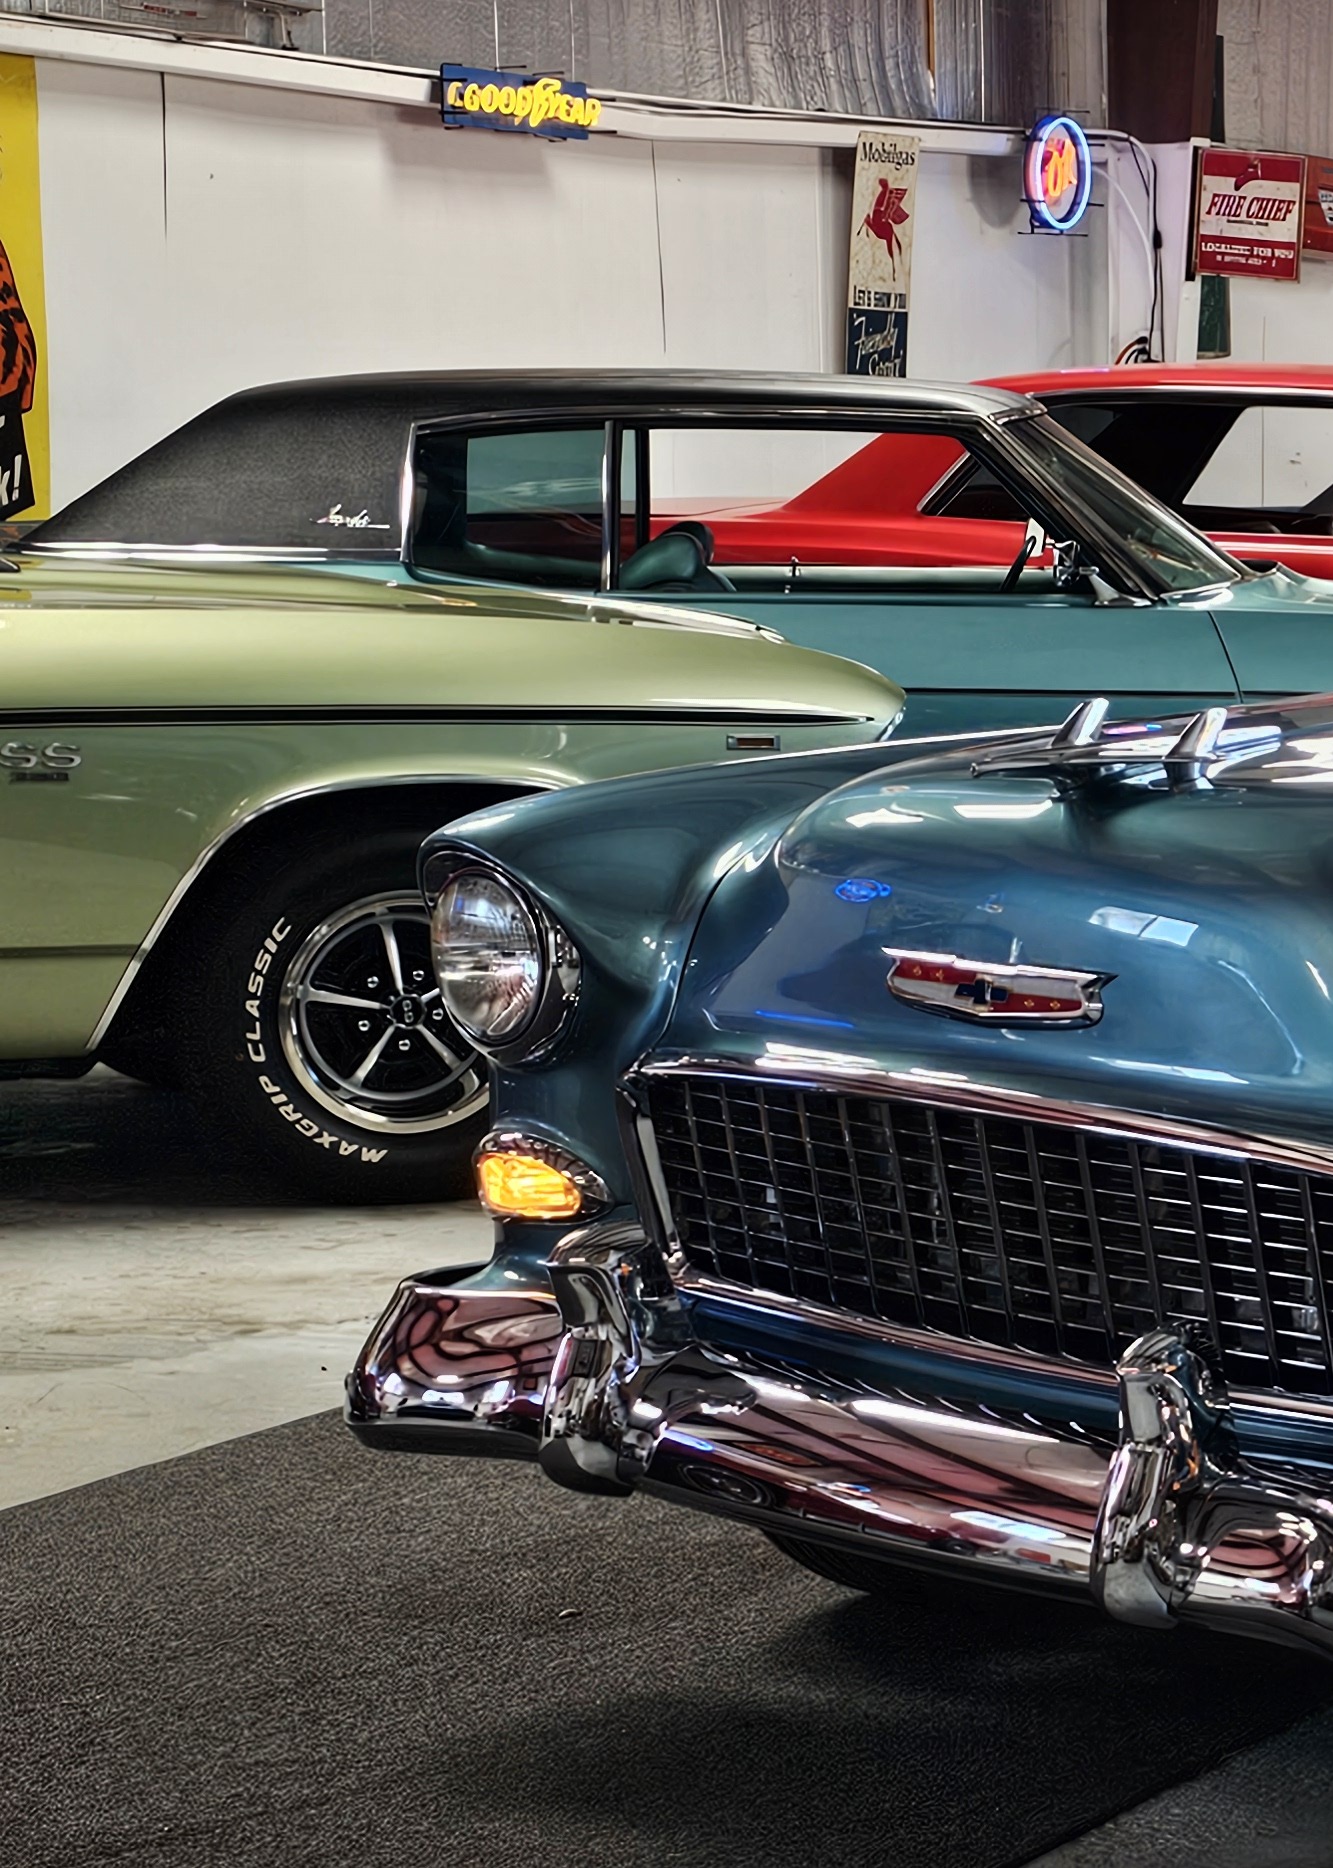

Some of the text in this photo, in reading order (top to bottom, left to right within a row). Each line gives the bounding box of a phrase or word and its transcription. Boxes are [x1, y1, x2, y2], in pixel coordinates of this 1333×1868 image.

[463, 78, 602, 128] GOODYEAR
[861, 141, 915, 171] Mobilgas
[1206, 193, 1296, 221] FIRE CHIEF
[0, 742, 82, 768] SS
[246, 917, 293, 1064] CLASSIC
[258, 1075, 388, 1163] MAXGRIP
